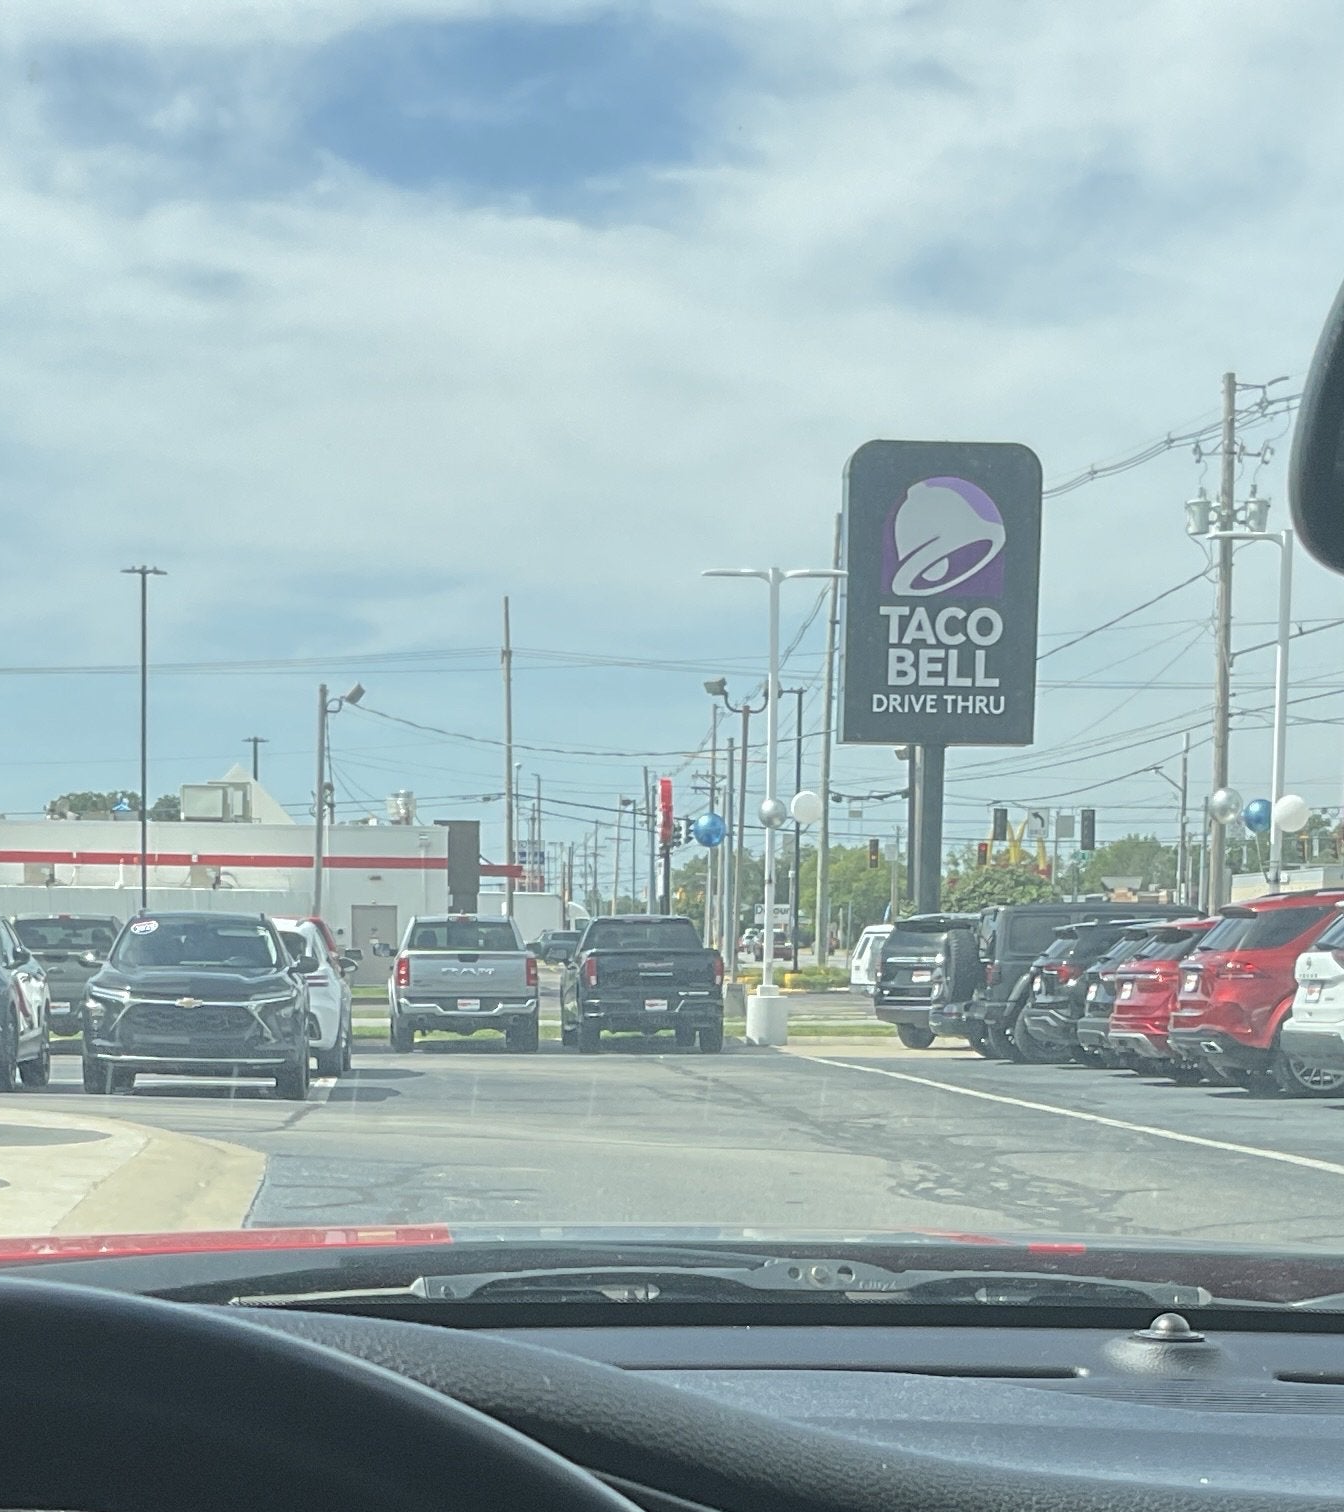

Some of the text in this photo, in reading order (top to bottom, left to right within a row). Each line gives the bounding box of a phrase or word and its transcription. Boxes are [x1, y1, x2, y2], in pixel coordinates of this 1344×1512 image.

[879, 606, 1003, 646] TACO
[887, 649, 1000, 687] BELL
[872, 694, 1005, 715] DRIVE THRU
